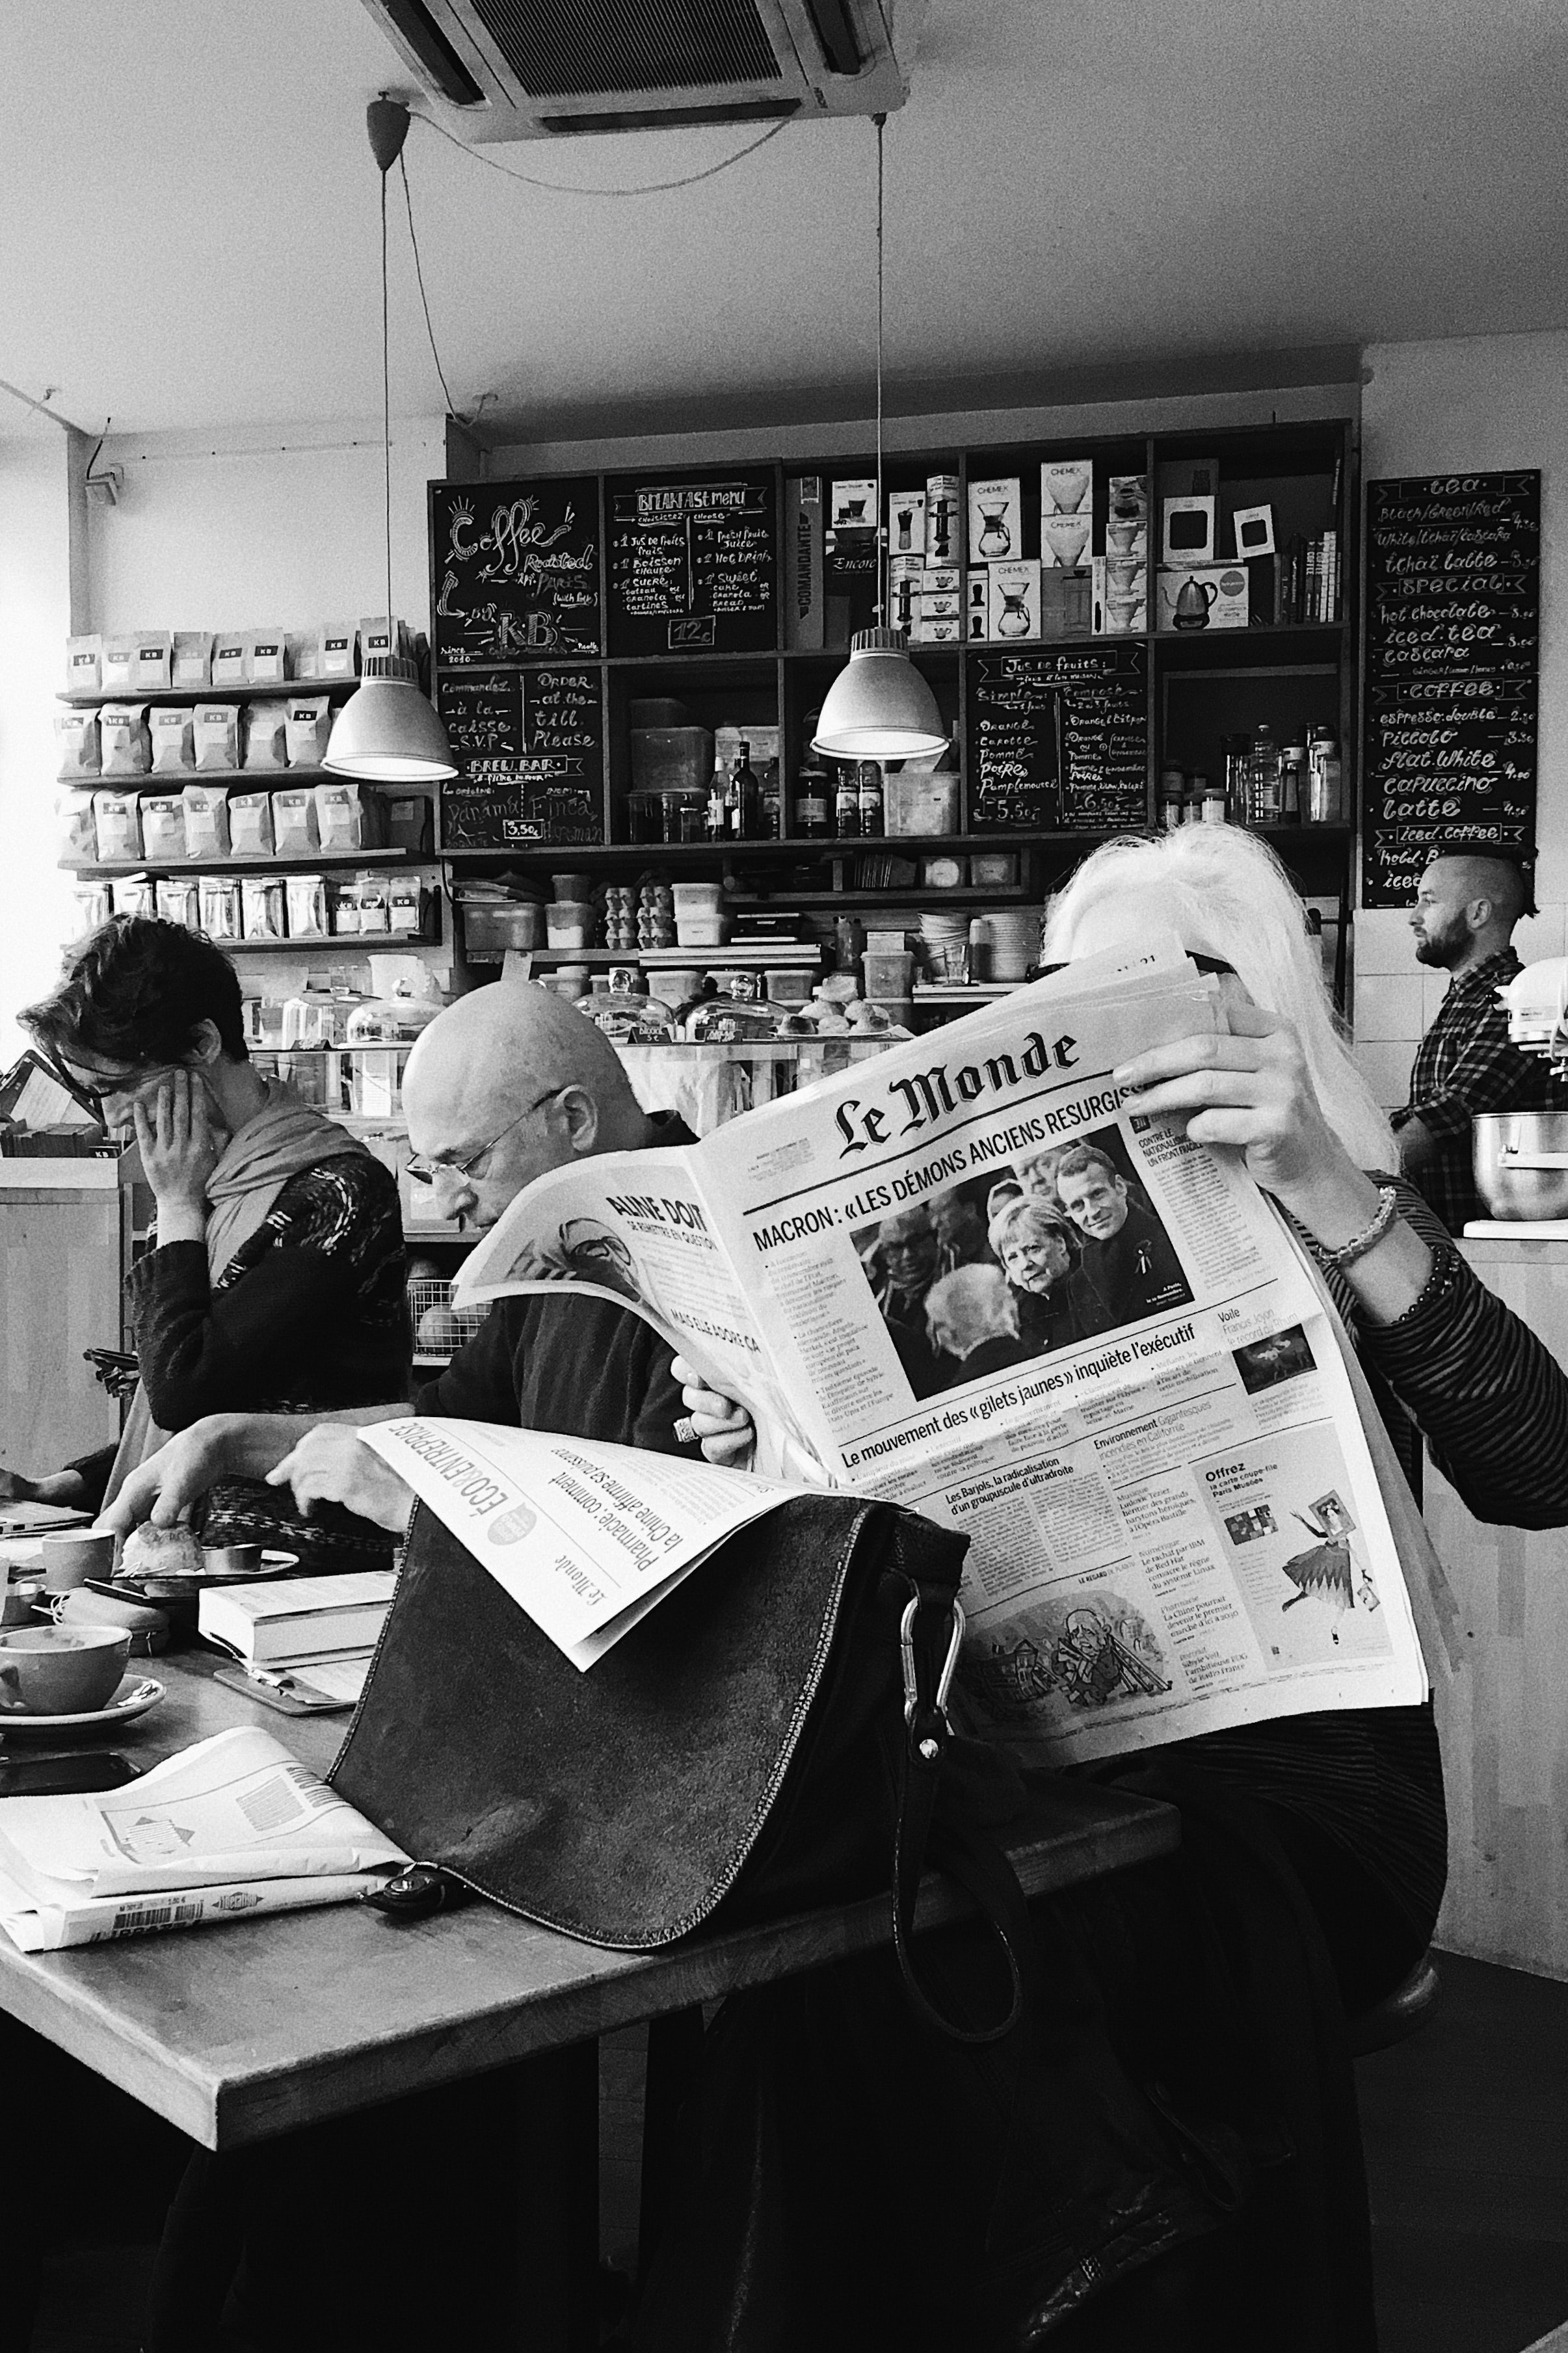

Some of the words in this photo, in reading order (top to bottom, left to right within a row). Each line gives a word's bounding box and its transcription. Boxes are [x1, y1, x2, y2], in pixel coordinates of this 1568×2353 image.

[977, 486, 1009, 494] CHEMEX
[797, 524, 812, 606] COMANDANTE
[832, 557, 877, 569] Encore
[834, 1100, 892, 1160] Le
[887, 1032, 1080, 1137] Monde
[891, 1150, 968, 1201] DÉMONS
[969, 1118, 1046, 1165] ANCIENS
[605, 1195, 666, 1221] ALINE
[660, 1198, 708, 1232] DOIT
[1217, 1307, 1240, 1323] Voile
[842, 1451, 860, 1469] Le
[860, 1416, 942, 1461] mouvement
[942, 1409, 968, 1429] des
[1073, 1349, 1132, 1381] inquiète
[1093, 1418, 1158, 1450] Environnement
[1158, 1401, 1212, 1426] Gigantesques
[1147, 1422, 1185, 1443] Californie
[946, 1493, 962, 1504] Les
[961, 1478, 994, 1499] Barjols,
[992, 1474, 1002, 1485] la
[1002, 1457, 1060, 1482] radicalisation
[1205, 1462, 1247, 1482] Offrez
[1219, 1476, 1240, 1489] carte
[548, 1472, 602, 1513] comment
[602, 1479, 644, 1511] affirme
[971, 1481, 1022, 1509] groupuscule
[1151, 1498, 1163, 1508] des
[1164, 1490, 1189, 1505] grands
[1212, 1485, 1234, 1498] Paris
[1234, 1477, 1264, 1491] Musées
[634, 1506, 672, 1543] Chine
[1125, 1508, 1158, 1525] barytons
[1160, 1508, 1188, 1521] Bastille
[663, 1537, 684, 1553] la
[1151, 1550, 1174, 1562] rachat
[1175, 1545, 1189, 1556] par
[1189, 1539, 1206, 1550] IBM
[1148, 1566, 1181, 1582] consacre
[1156, 1560, 1171, 1570] Red
[1171, 1555, 1185, 1565] Hat
[555, 1554, 589, 1596] Monde
[1152, 1582, 1162, 1590] du
[1193, 1563, 1216, 1576] Linux
[1167, 1617, 1195, 1630] devenir
[1203, 1602, 1232, 1619] premier
[1173, 1605, 1195, 1619] Chine
[1195, 1595, 1227, 1613] pourrait
[1188, 1675, 1198, 1684] de
[1198, 1668, 1221, 1682] Radio
[1220, 1662, 1245, 1675] France
